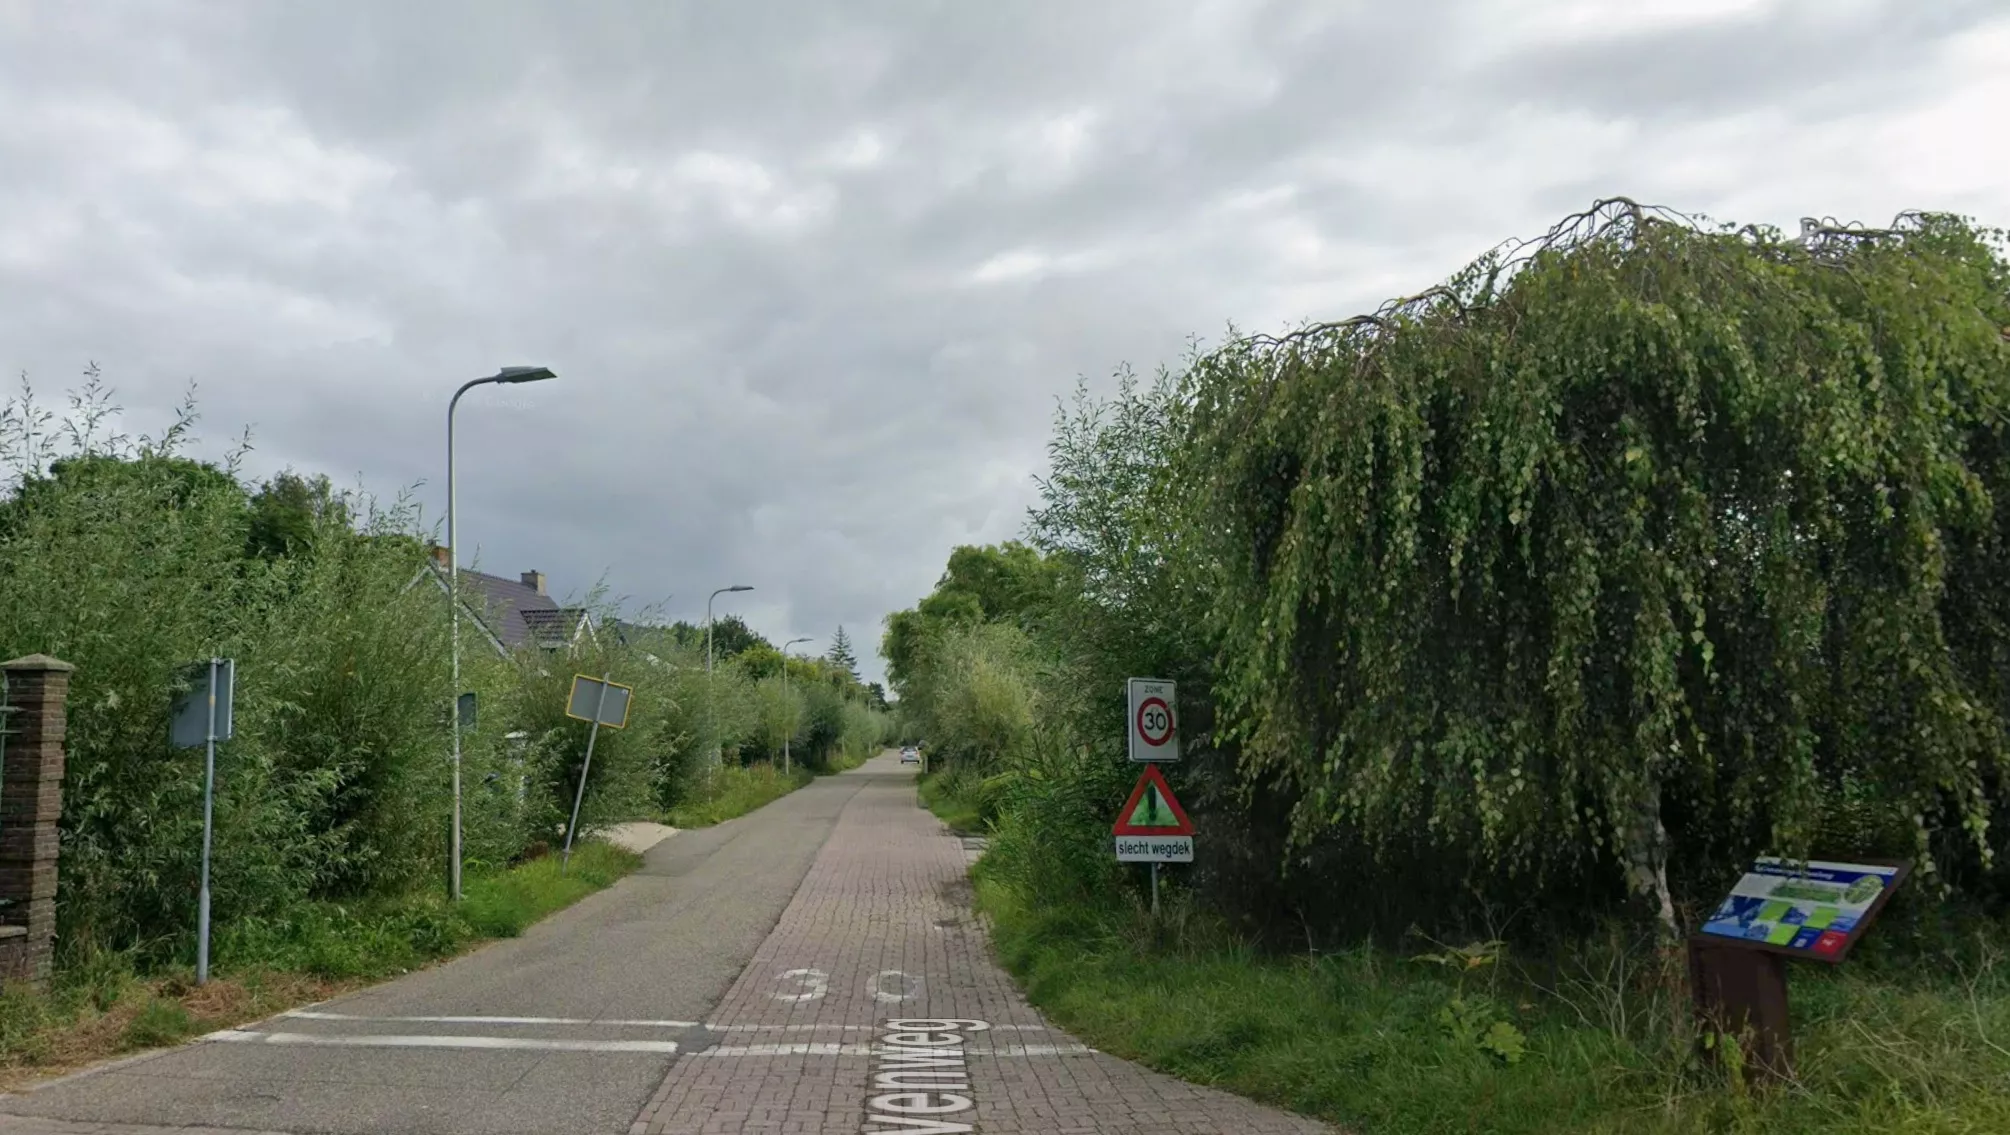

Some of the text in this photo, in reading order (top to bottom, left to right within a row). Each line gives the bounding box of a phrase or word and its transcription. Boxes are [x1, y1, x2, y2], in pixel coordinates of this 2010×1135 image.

[1144, 685, 1165, 694] ZONE
[1144, 712, 1167, 731] 30
[1119, 841, 1190, 858] slecht wegdek
